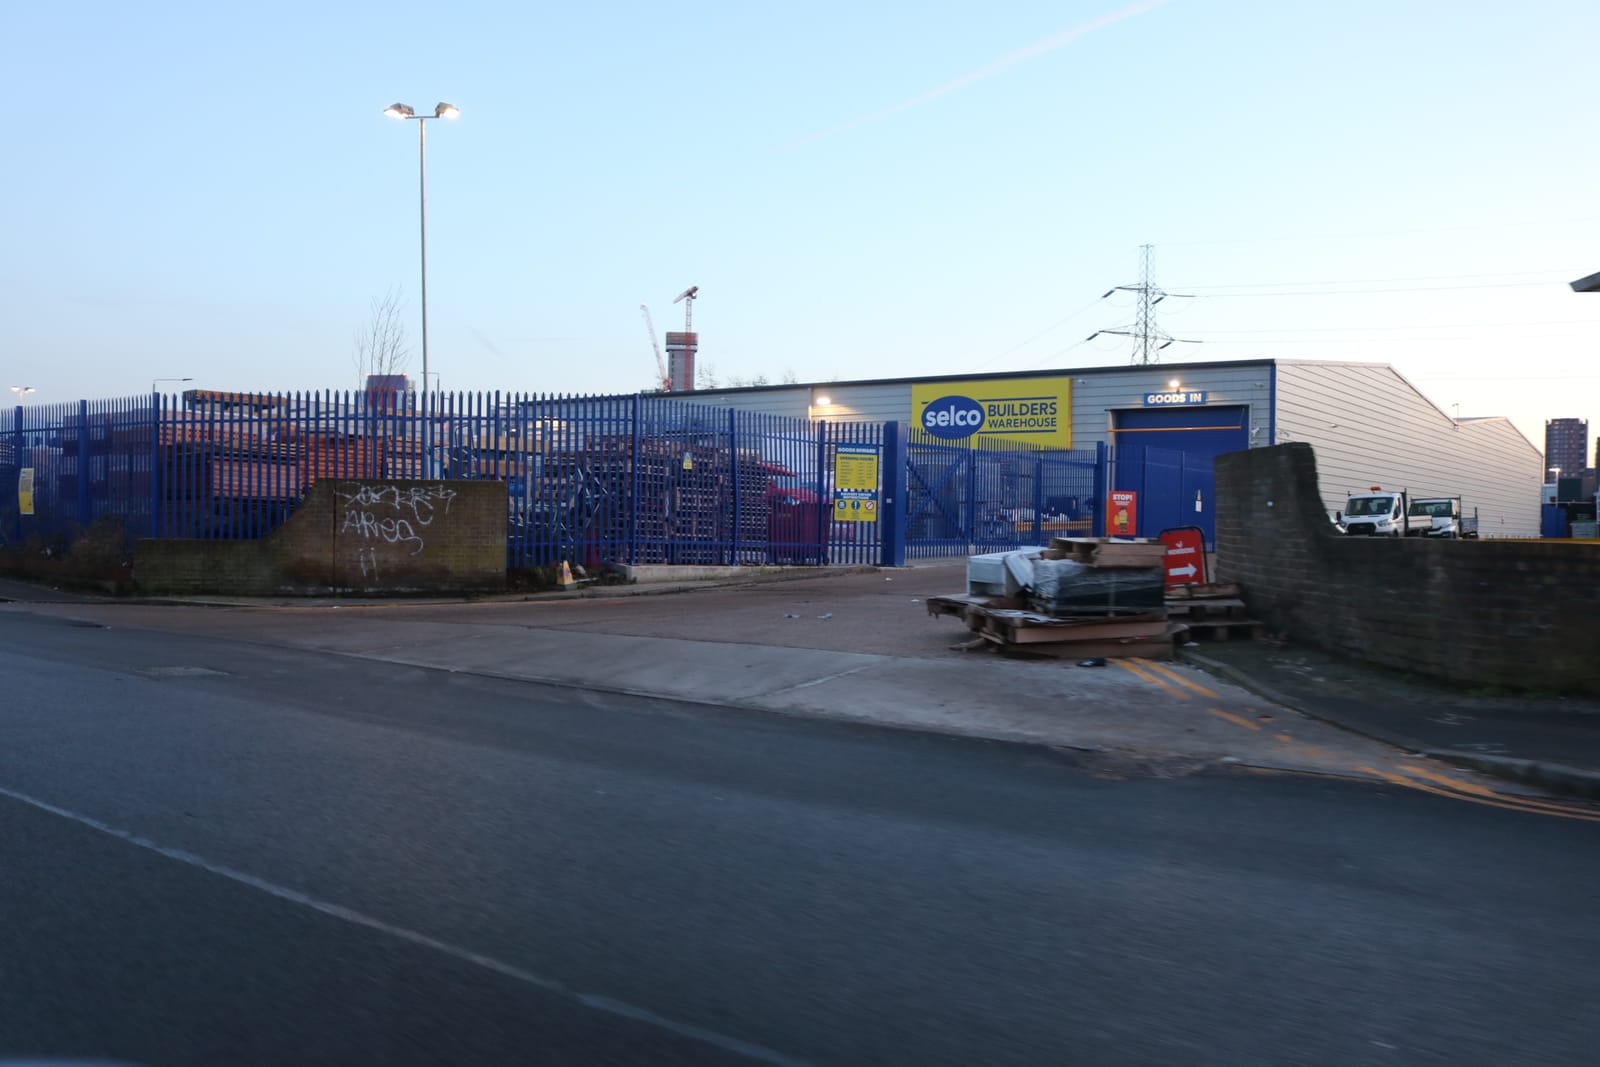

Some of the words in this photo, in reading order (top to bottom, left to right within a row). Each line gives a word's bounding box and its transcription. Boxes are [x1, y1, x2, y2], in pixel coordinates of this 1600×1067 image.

[1147, 393, 1186, 404] GOODS
[1190, 392, 1202, 403] IN
[925, 404, 982, 427] selco
[987, 401, 1057, 417] BUILDERS
[987, 417, 1057, 429] WAREHOUSE
